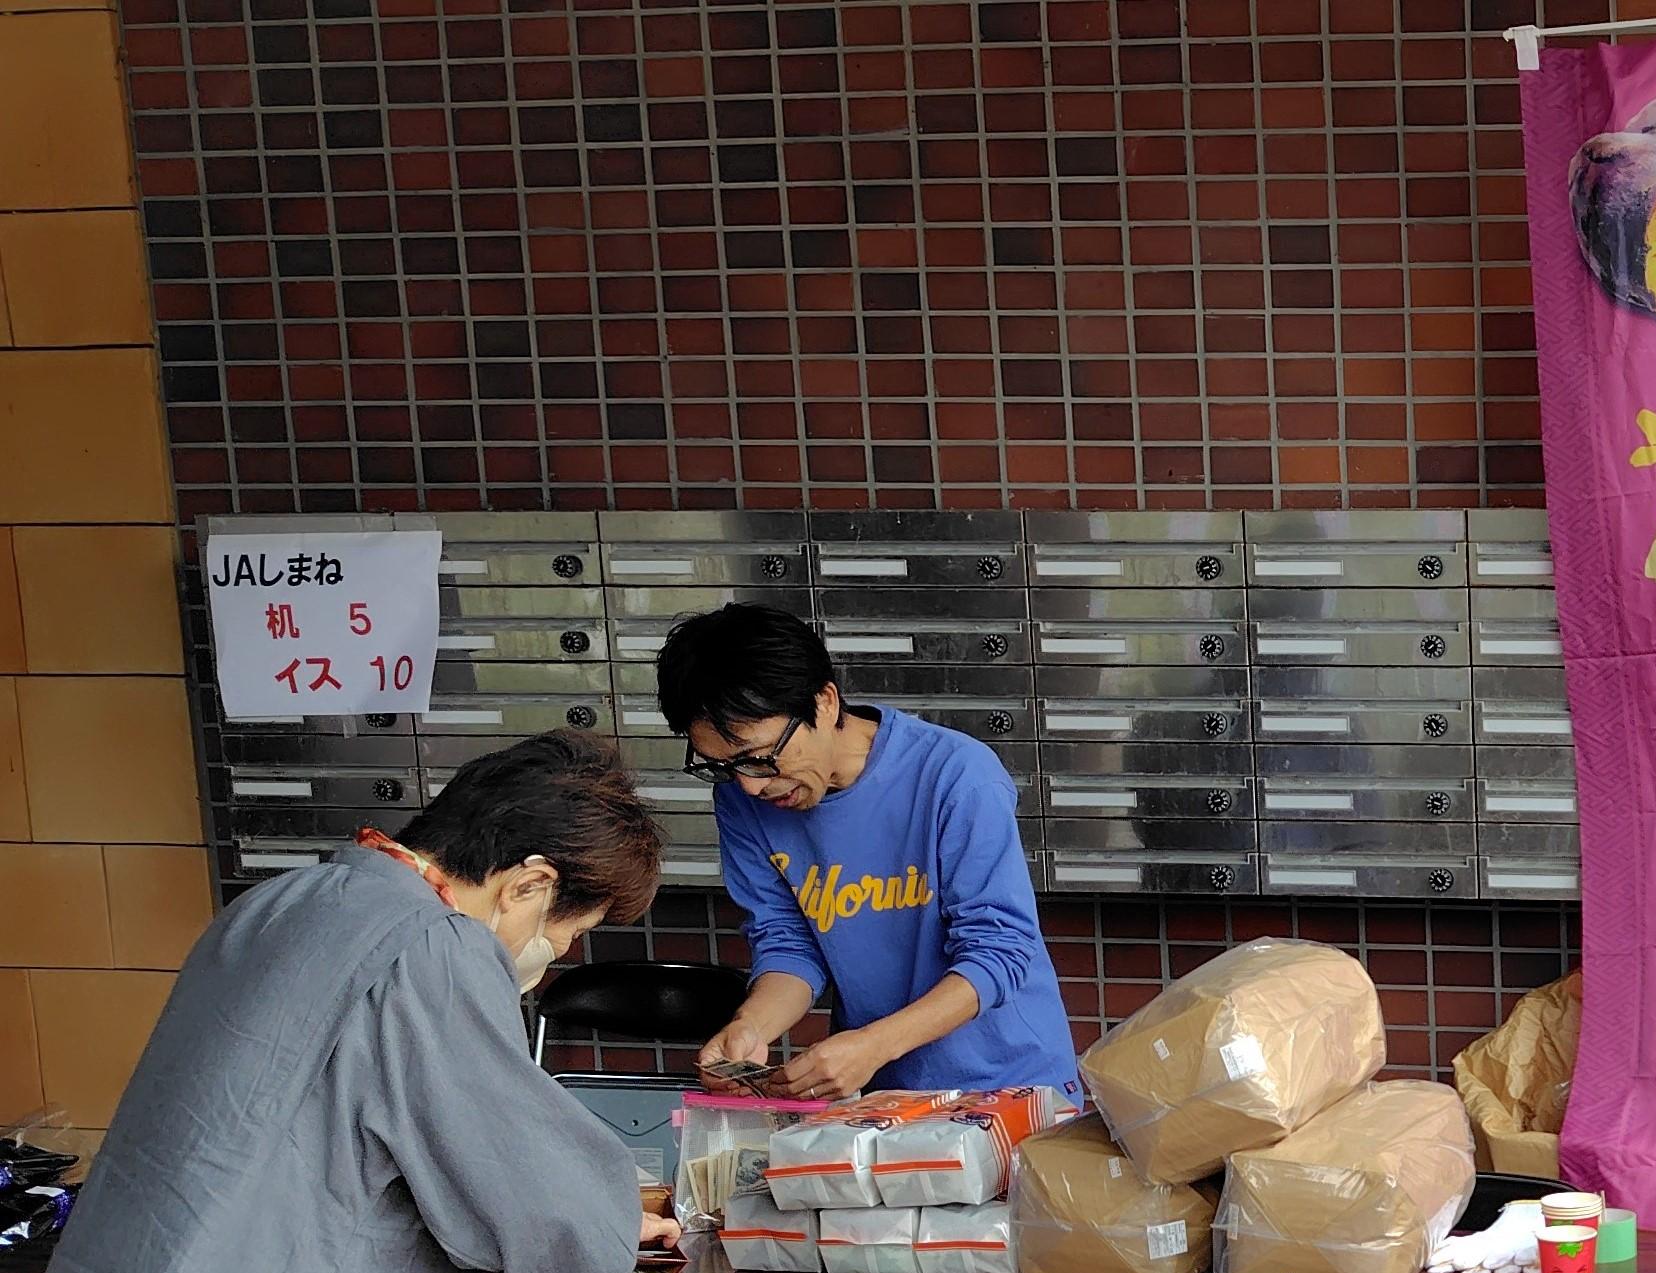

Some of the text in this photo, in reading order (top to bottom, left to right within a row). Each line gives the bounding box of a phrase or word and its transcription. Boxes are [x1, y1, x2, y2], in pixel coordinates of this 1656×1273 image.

[212, 551, 345, 588] JAしまね
[265, 602, 373, 640] 机 5
[274, 654, 414, 694] イス 10
[770, 852, 933, 933] lifornia
